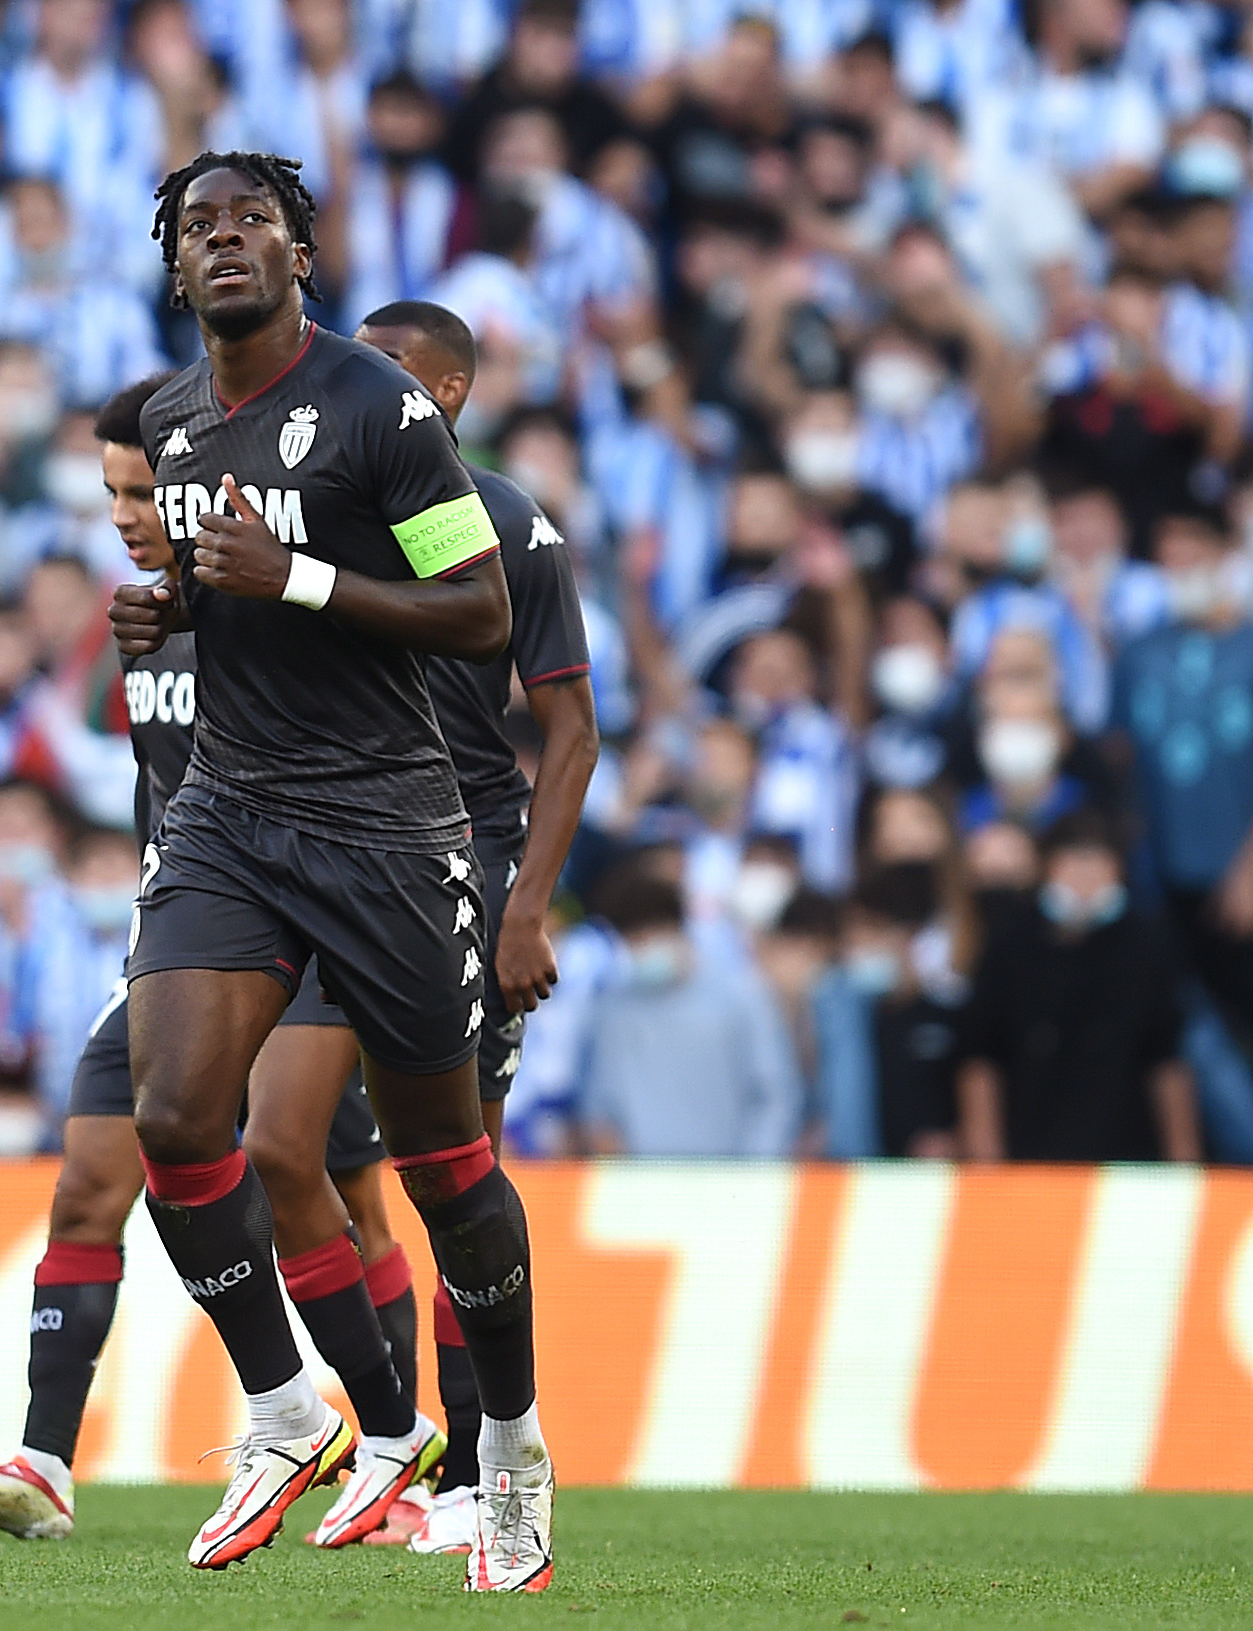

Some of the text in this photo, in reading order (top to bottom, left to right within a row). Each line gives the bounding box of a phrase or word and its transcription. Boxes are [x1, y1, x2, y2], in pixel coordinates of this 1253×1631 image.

[419, 525, 436, 537] TO
[432, 524, 479, 553] RESPECT
[180, 1260, 253, 1298] NACO
